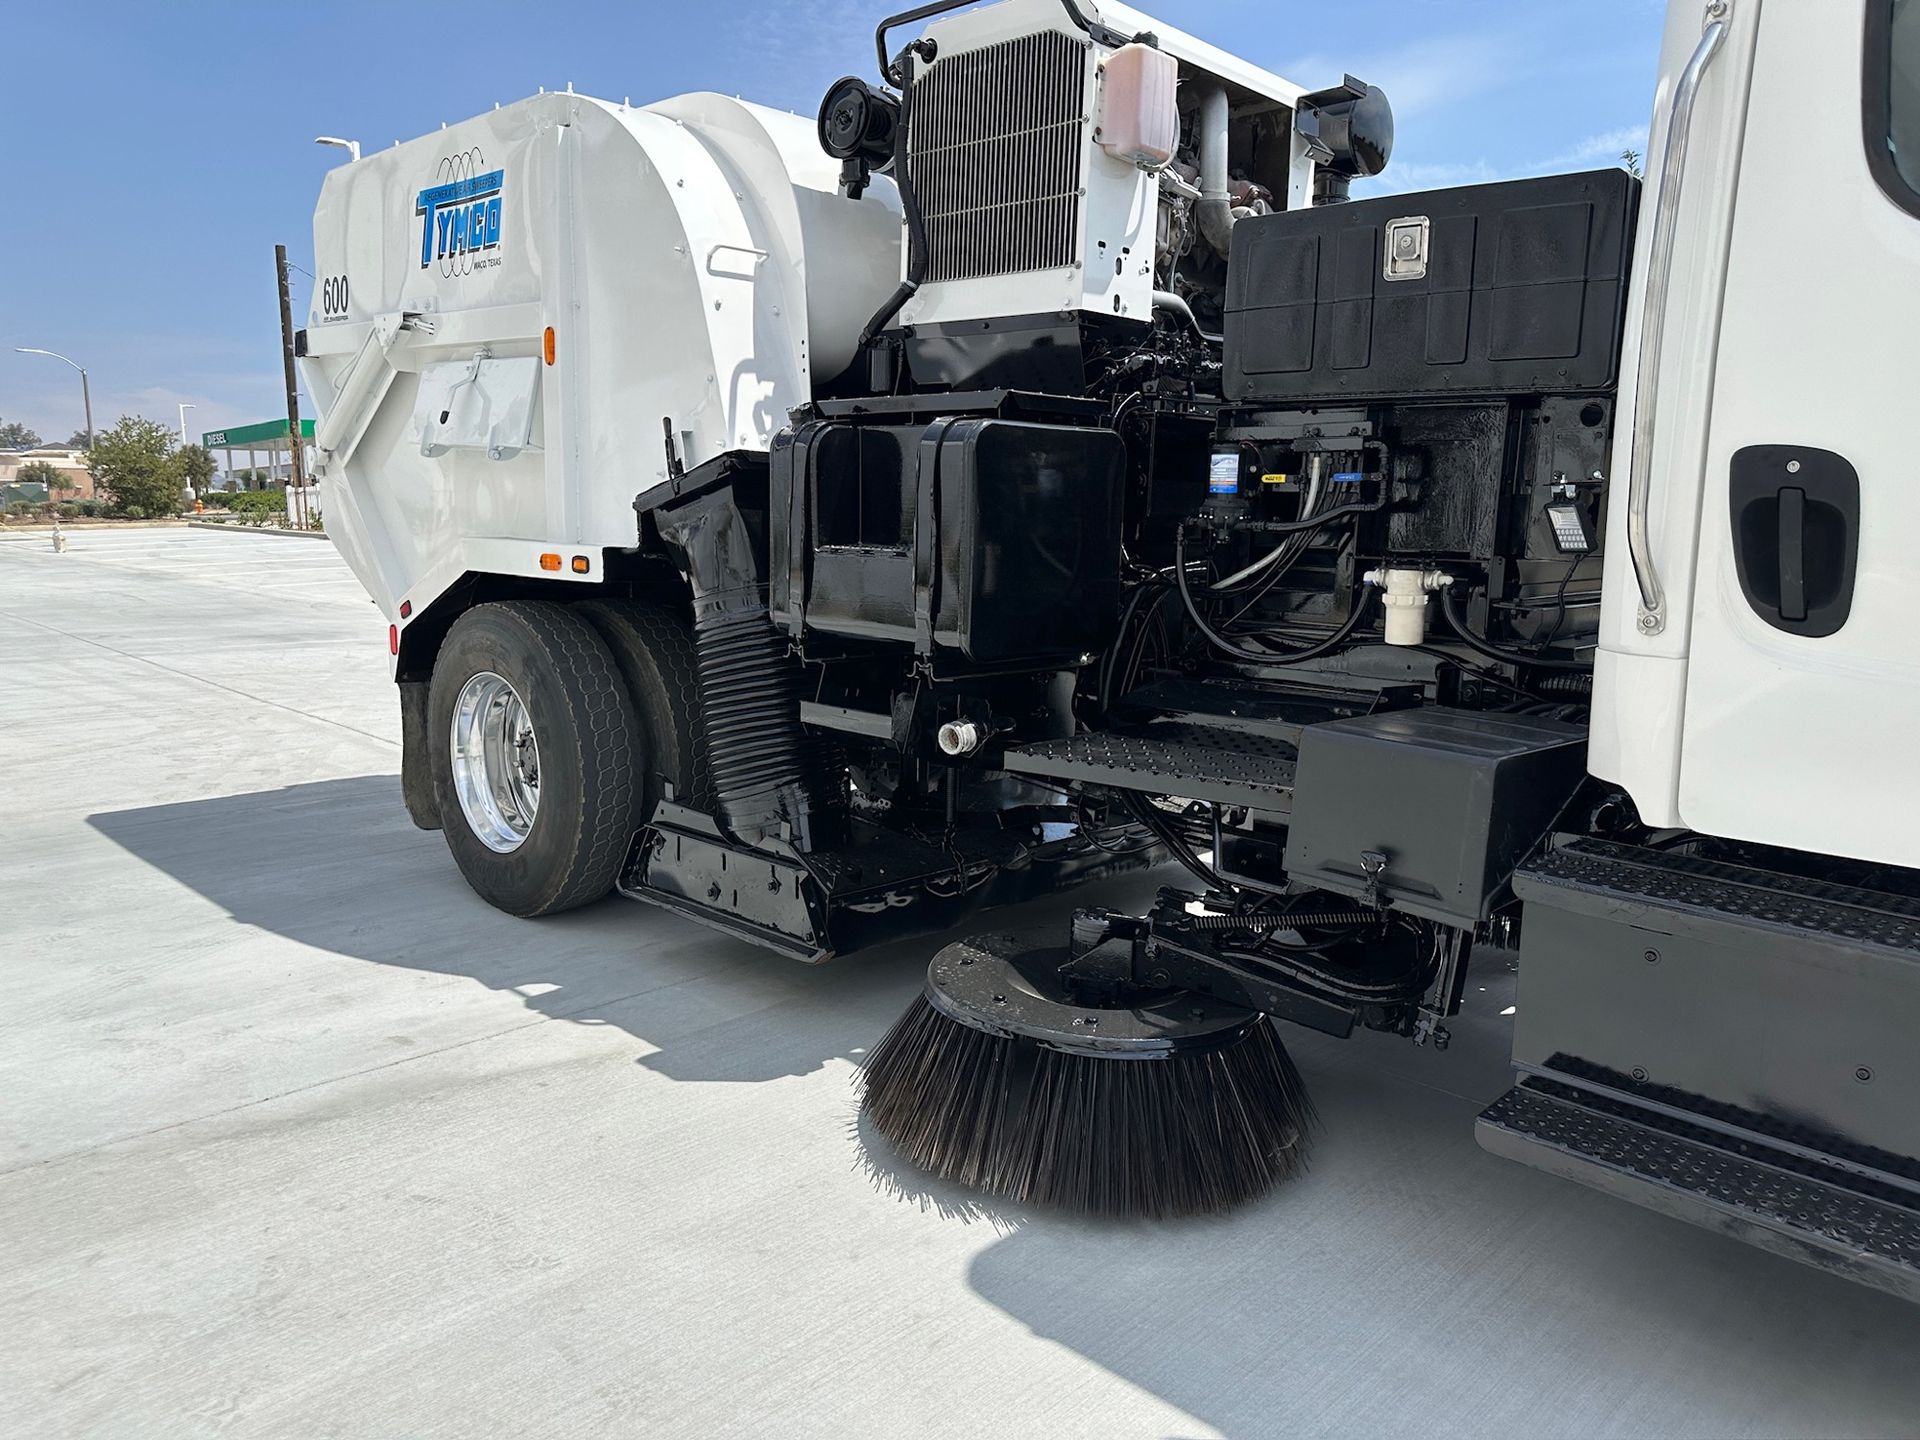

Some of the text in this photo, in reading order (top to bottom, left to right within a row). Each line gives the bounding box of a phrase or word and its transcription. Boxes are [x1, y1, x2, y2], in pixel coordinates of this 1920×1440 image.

[416, 169, 504, 269] TYMCO
[323, 274, 349, 315] 600
[207, 433, 226, 445] DIESEL
